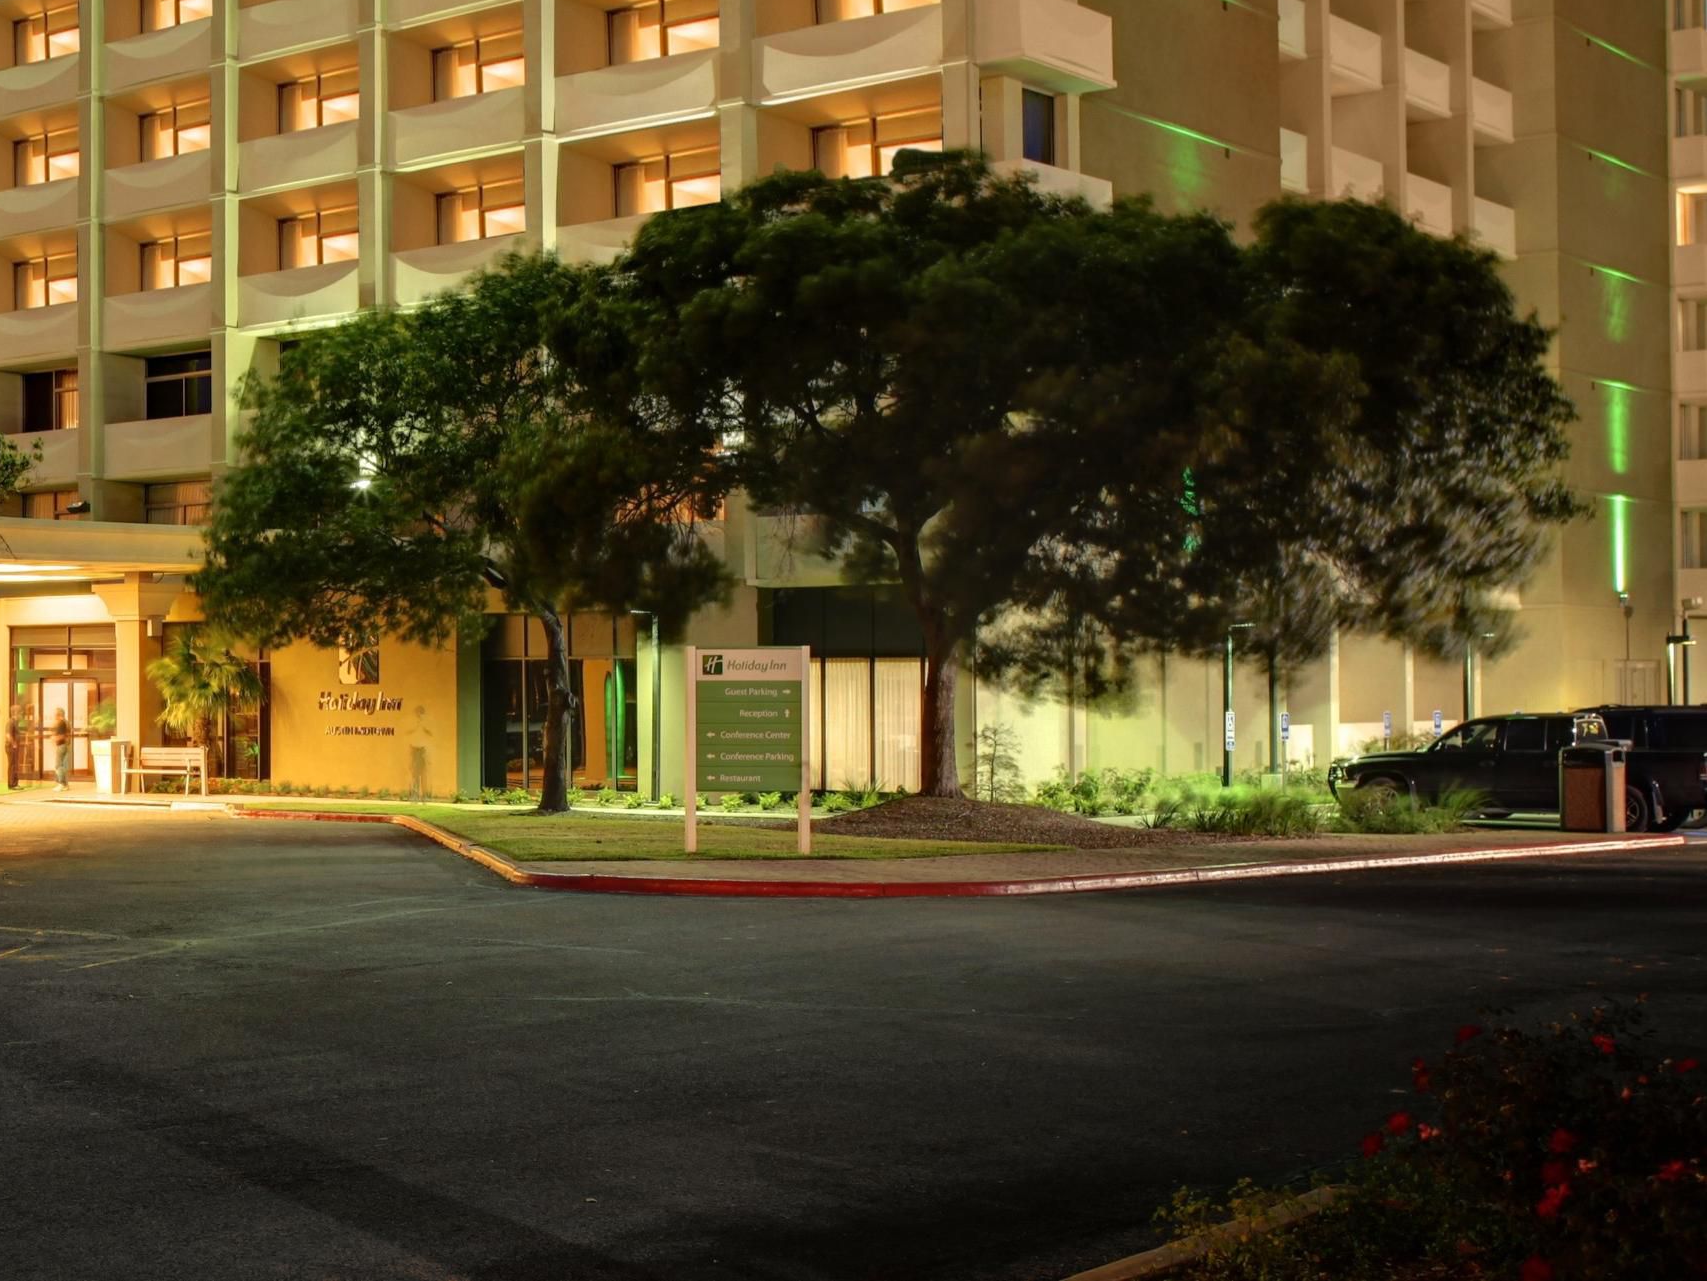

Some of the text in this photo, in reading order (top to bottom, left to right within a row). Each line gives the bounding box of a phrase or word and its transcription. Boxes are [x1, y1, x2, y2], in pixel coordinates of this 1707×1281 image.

[727, 659, 787, 672] Holiday Inn
[724, 687, 778, 698] Guest Parking
[318, 691, 376, 715] Holiday
[739, 709, 778, 718] Reception
[720, 730, 791, 740] Conference Center
[720, 752, 795, 762] Conference Parking
[720, 773, 761, 782] Restaurant
